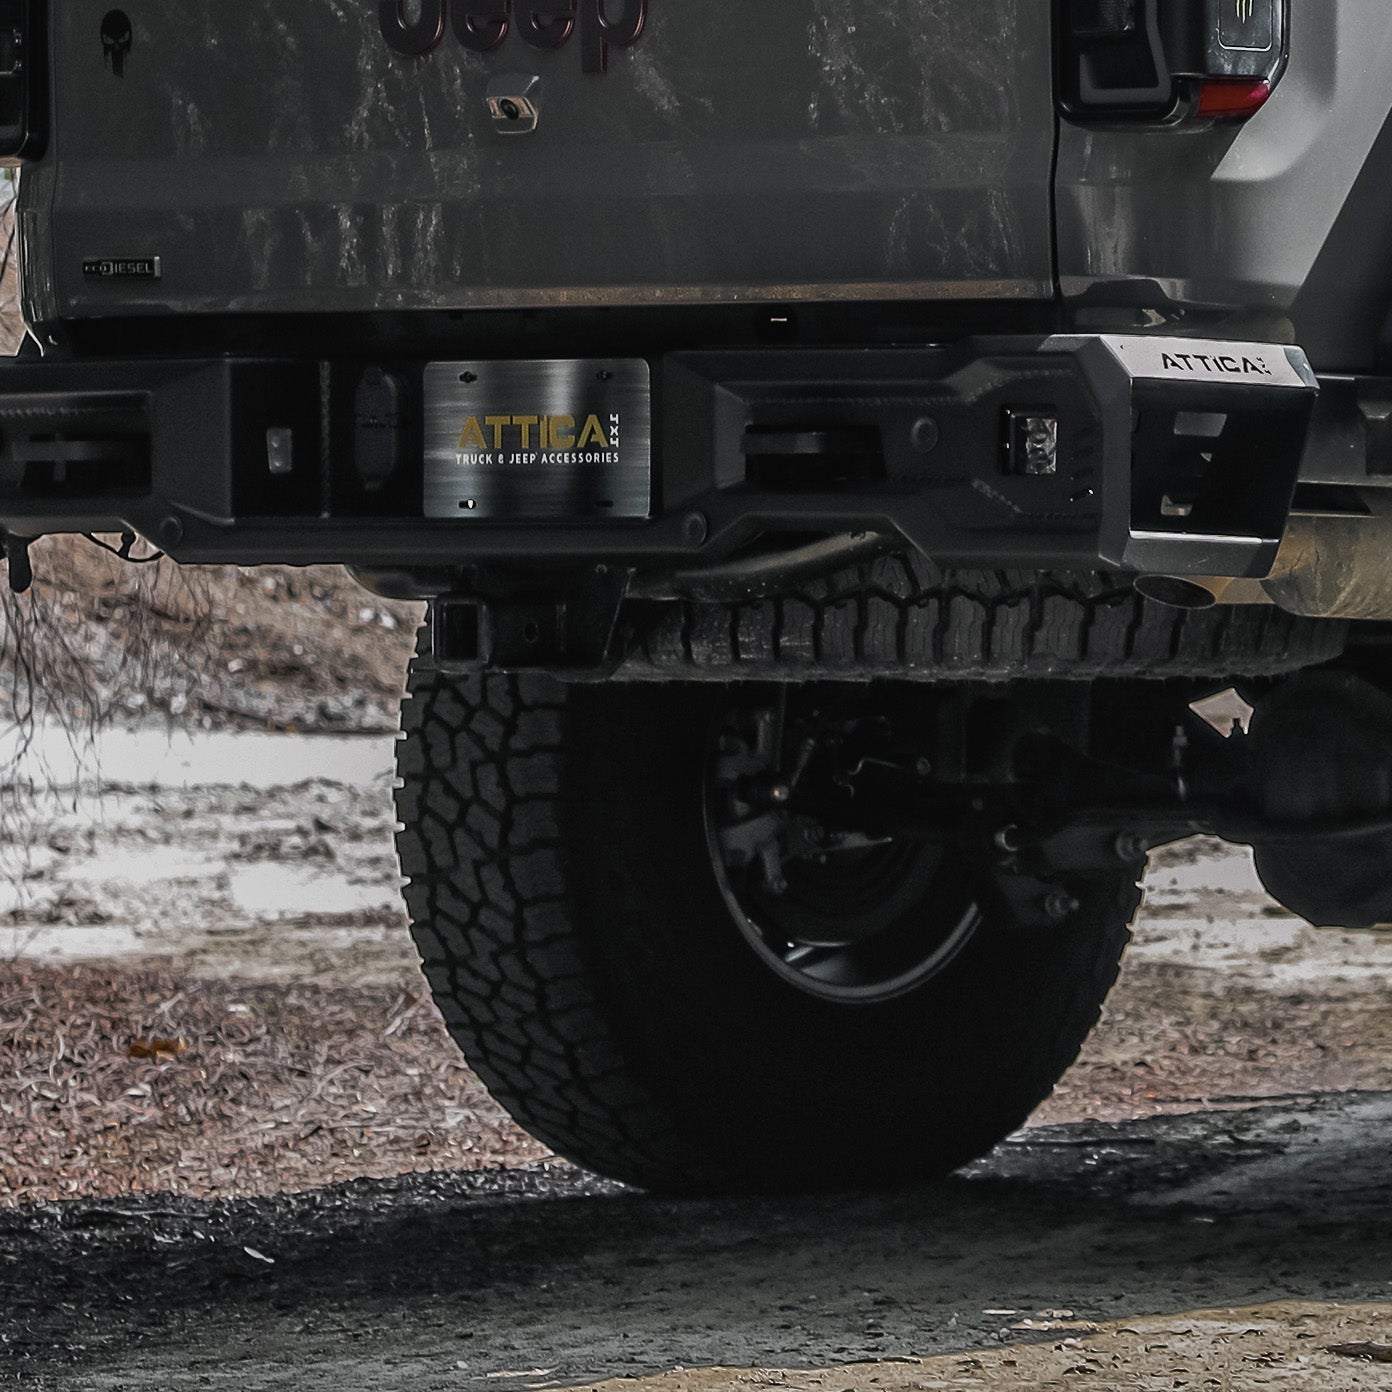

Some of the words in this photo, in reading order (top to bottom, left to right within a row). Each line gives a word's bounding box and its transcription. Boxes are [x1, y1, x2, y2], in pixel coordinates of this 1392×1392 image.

[1161, 352, 1265, 375] ATTICA
[457, 414, 609, 449] ATTICA
[456, 453, 492, 465] TRUCK
[541, 452, 619, 464] ACCESSORIES
